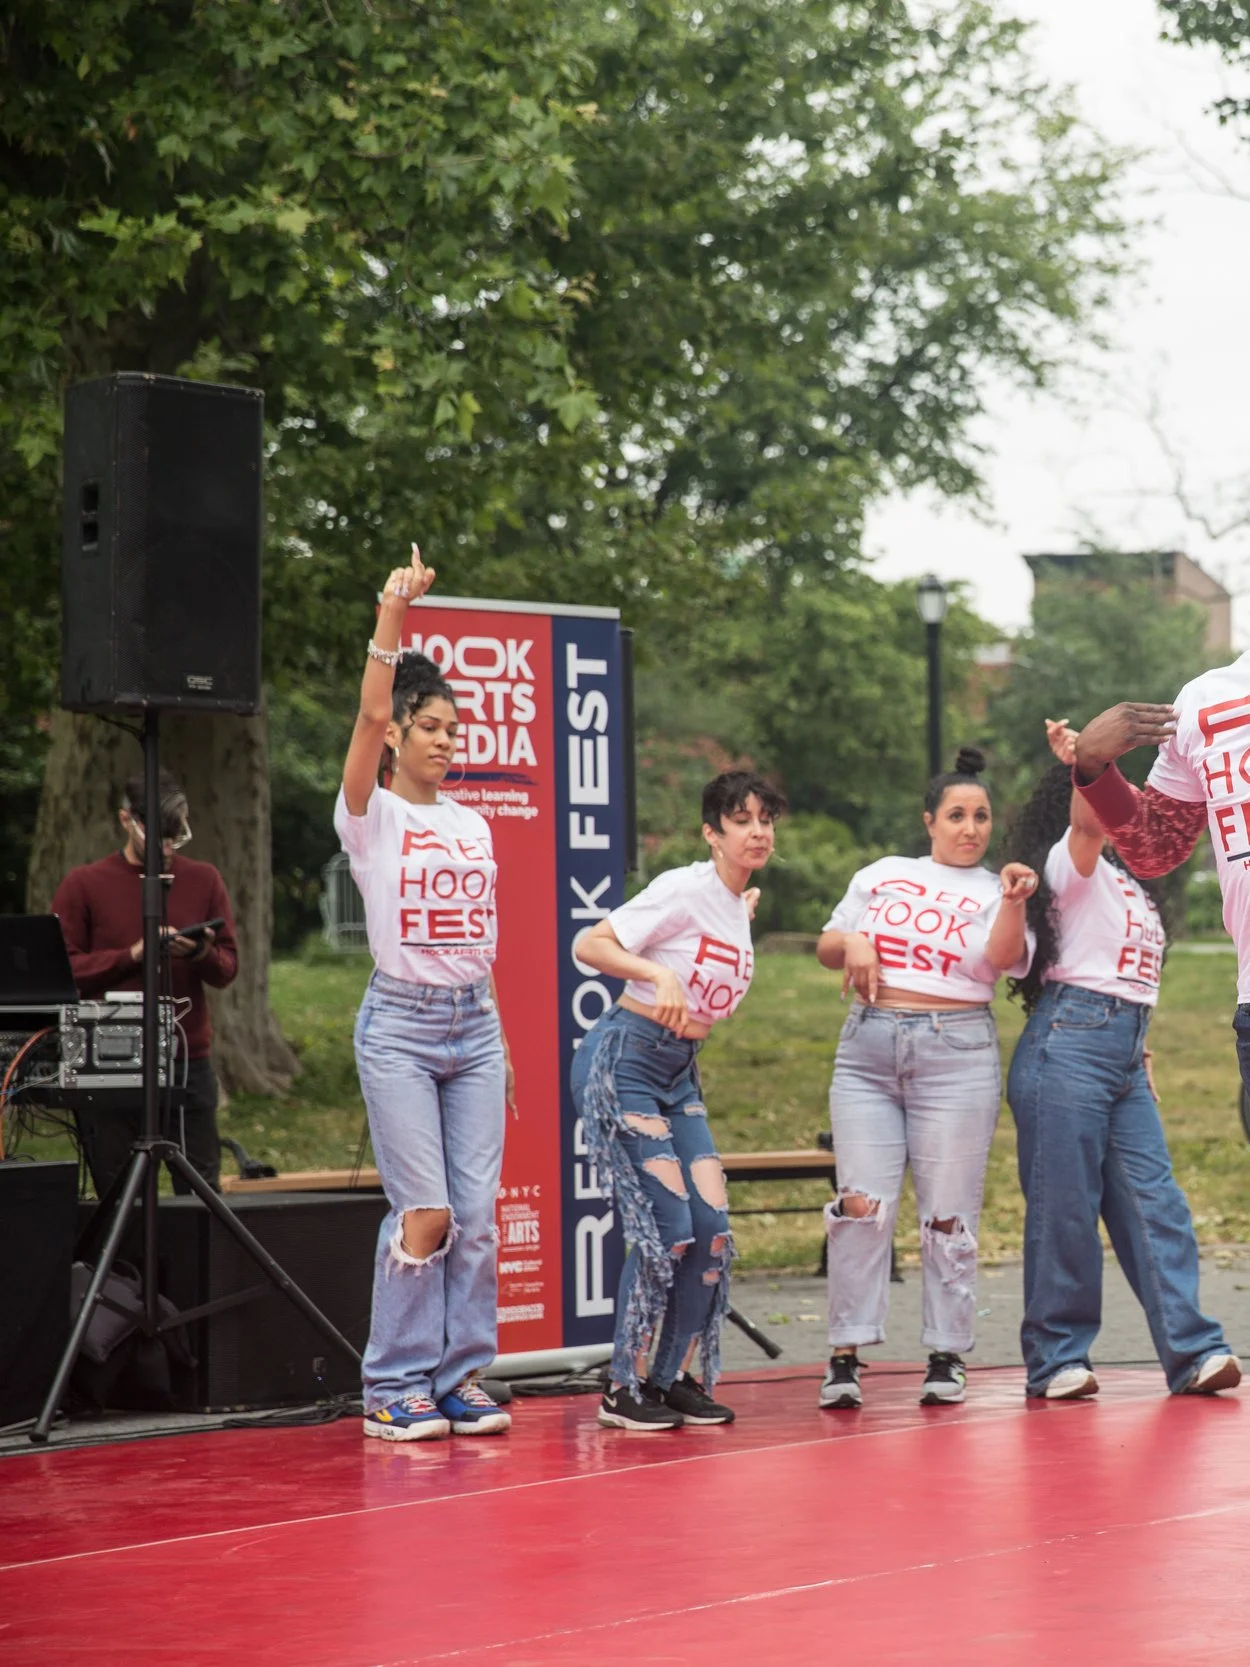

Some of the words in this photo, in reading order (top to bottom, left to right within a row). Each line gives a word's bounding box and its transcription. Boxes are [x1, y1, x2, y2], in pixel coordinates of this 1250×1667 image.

[447, 681, 537, 724] RTS
[452, 724, 538, 766] EDIA
[566, 642, 611, 850] FEST
[570, 875, 612, 1050] OOK
[860, 931, 962, 977] EST
[508, 1219, 540, 1245] ARTS
